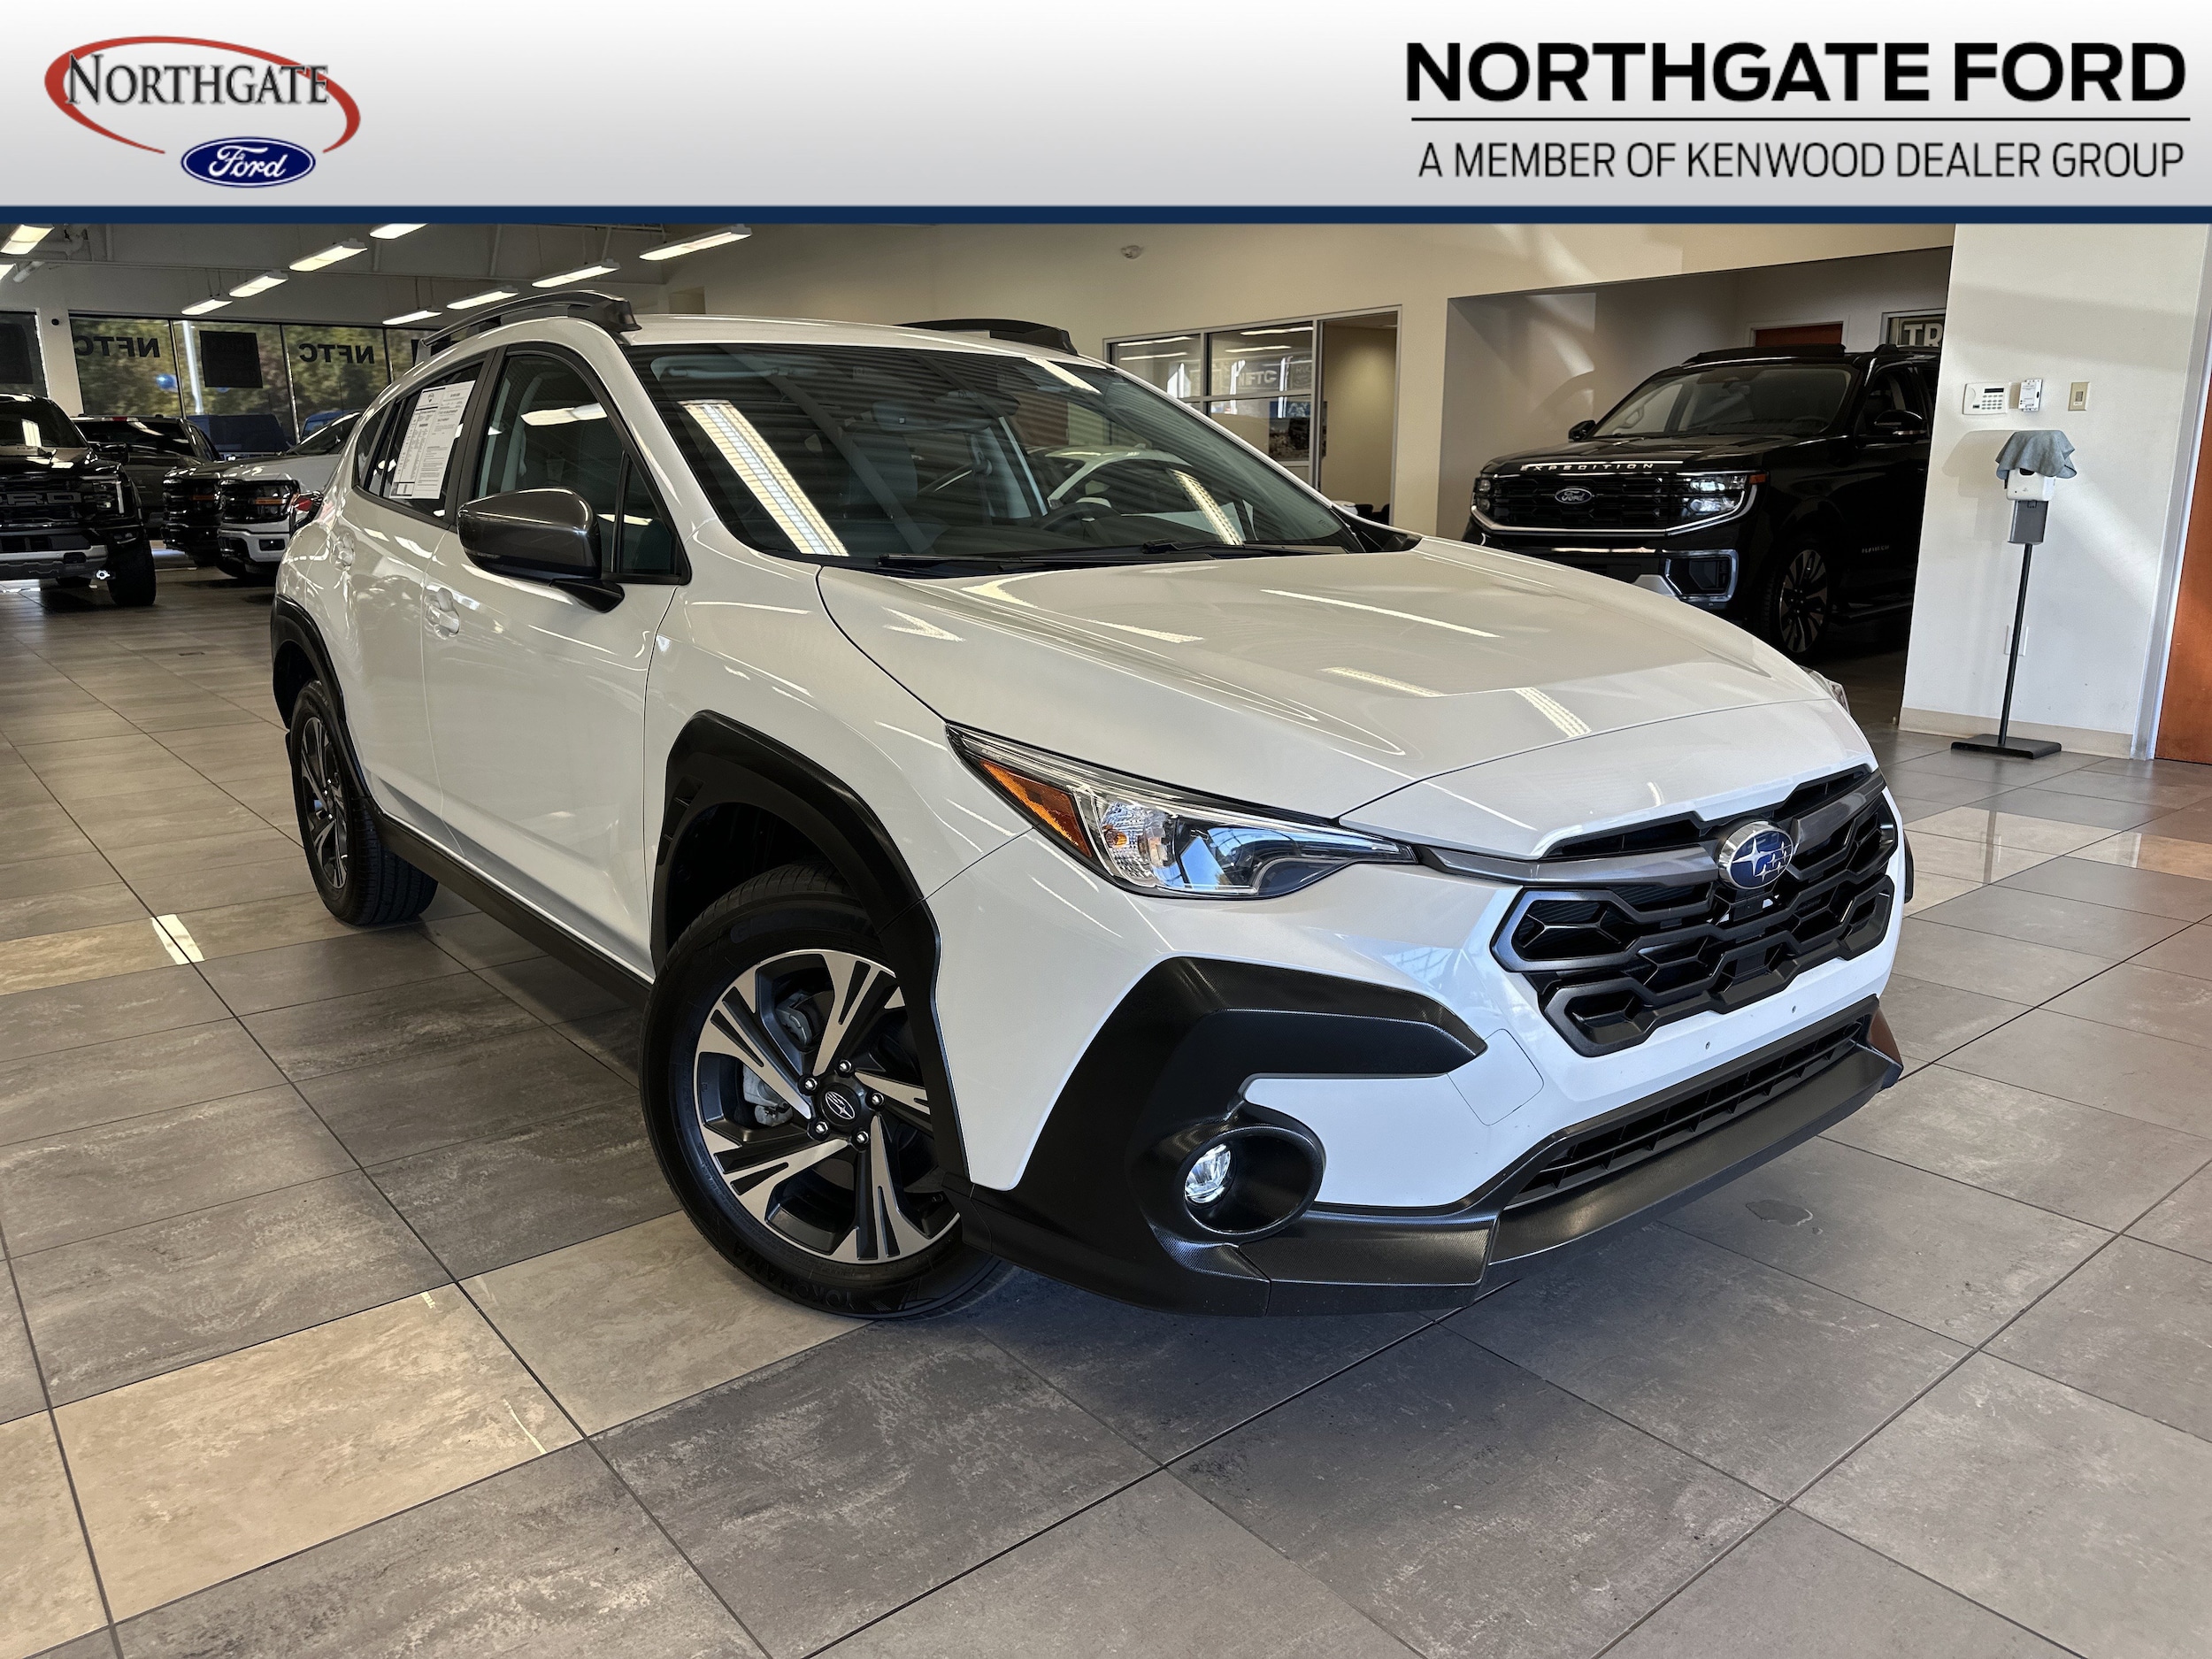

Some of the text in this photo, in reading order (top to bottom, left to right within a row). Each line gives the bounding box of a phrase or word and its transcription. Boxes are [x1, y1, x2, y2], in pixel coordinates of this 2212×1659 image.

[1519, 462, 1655, 472] EXPEDITION
[0, 491, 82, 506] RD
[1561, 490, 1586, 503] Ford
